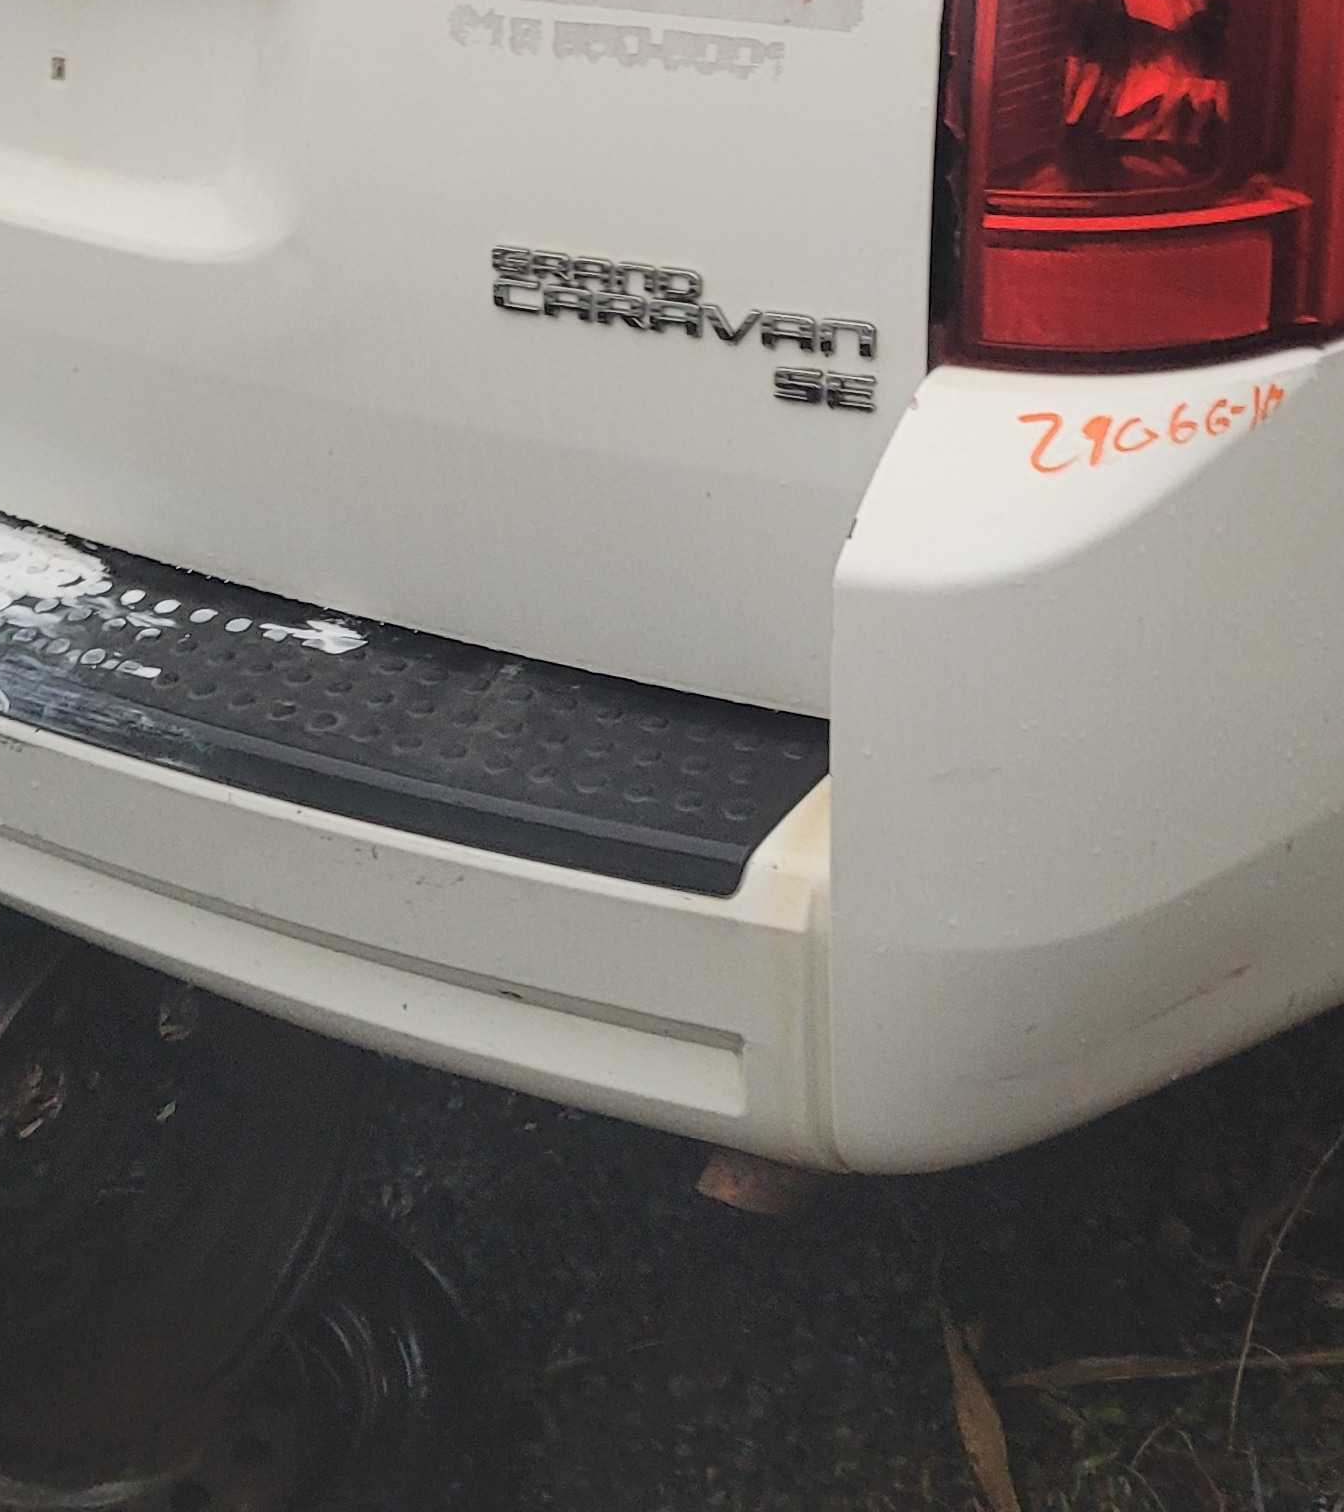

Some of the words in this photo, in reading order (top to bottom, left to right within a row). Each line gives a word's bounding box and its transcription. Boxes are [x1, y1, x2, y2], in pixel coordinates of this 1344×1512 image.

[492, 245, 704, 300] GRAND
[493, 275, 878, 360] CARAVAN
[773, 366, 877, 414] SE
